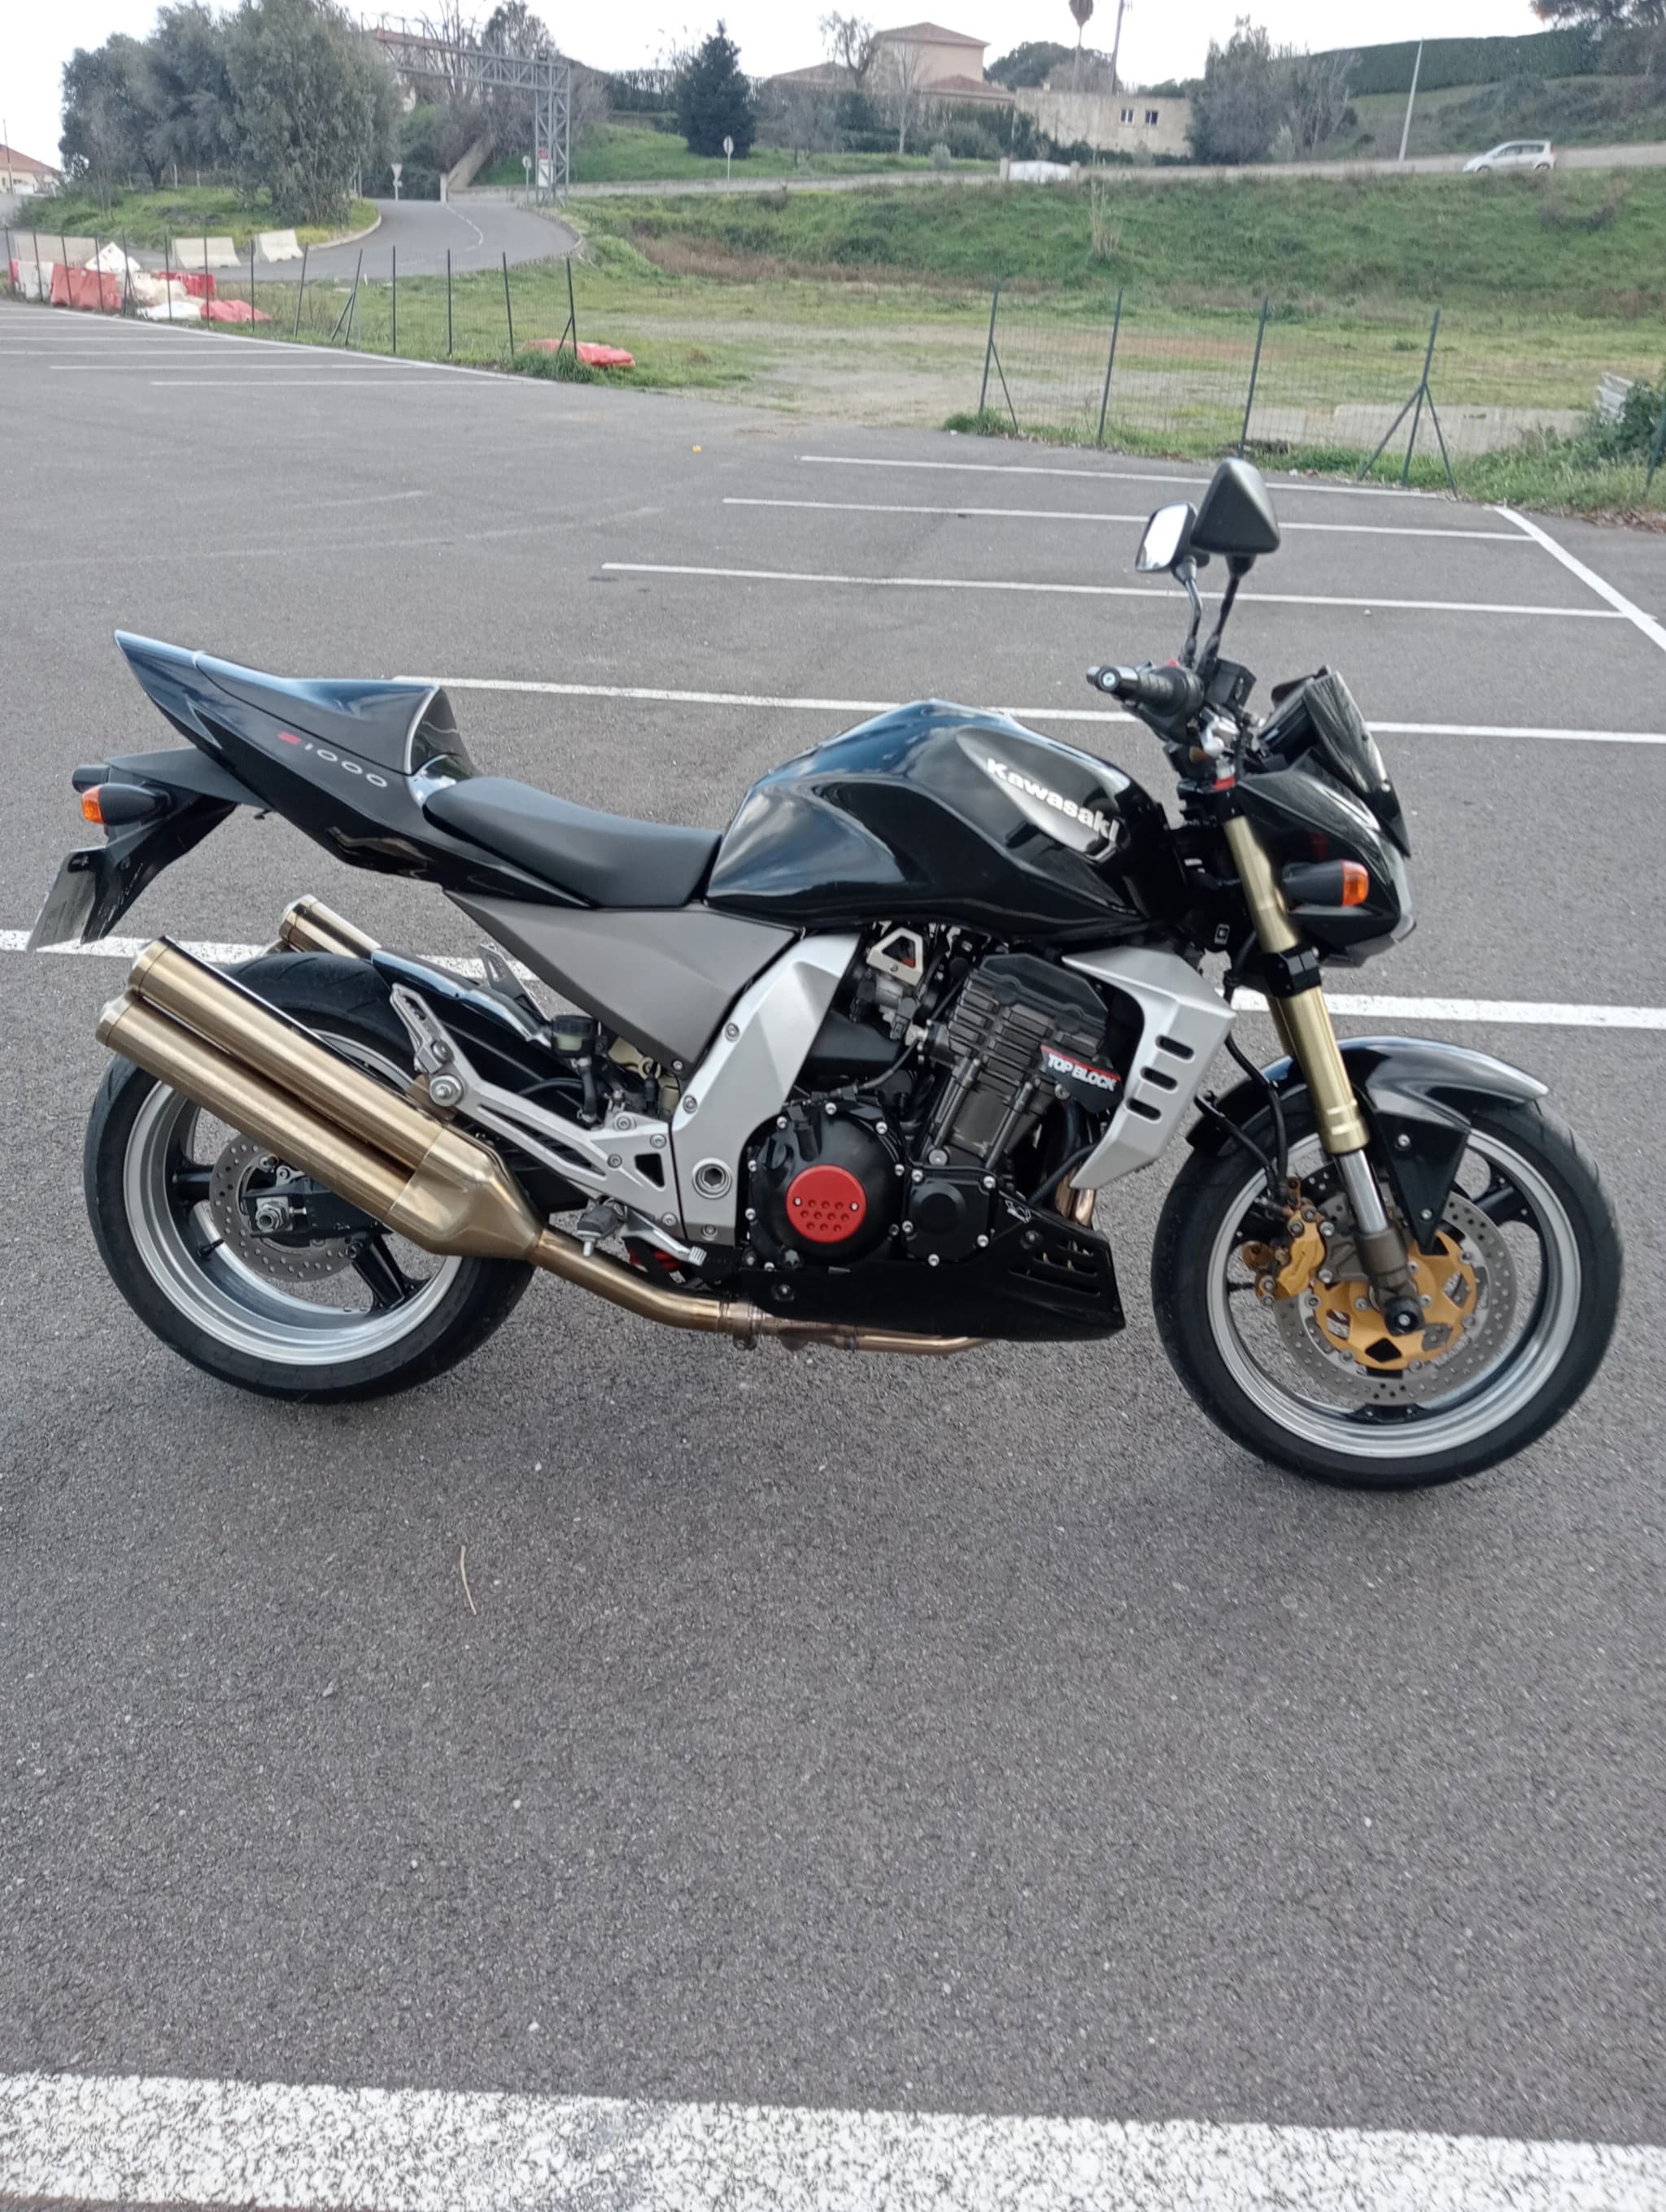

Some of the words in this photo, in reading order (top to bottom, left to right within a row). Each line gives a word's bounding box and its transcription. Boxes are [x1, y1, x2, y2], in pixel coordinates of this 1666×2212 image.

[987, 758, 1119, 843] Kawasaki
[1048, 1053, 1074, 1073] TOP
[1071, 1065, 1117, 1092] BLOCK
